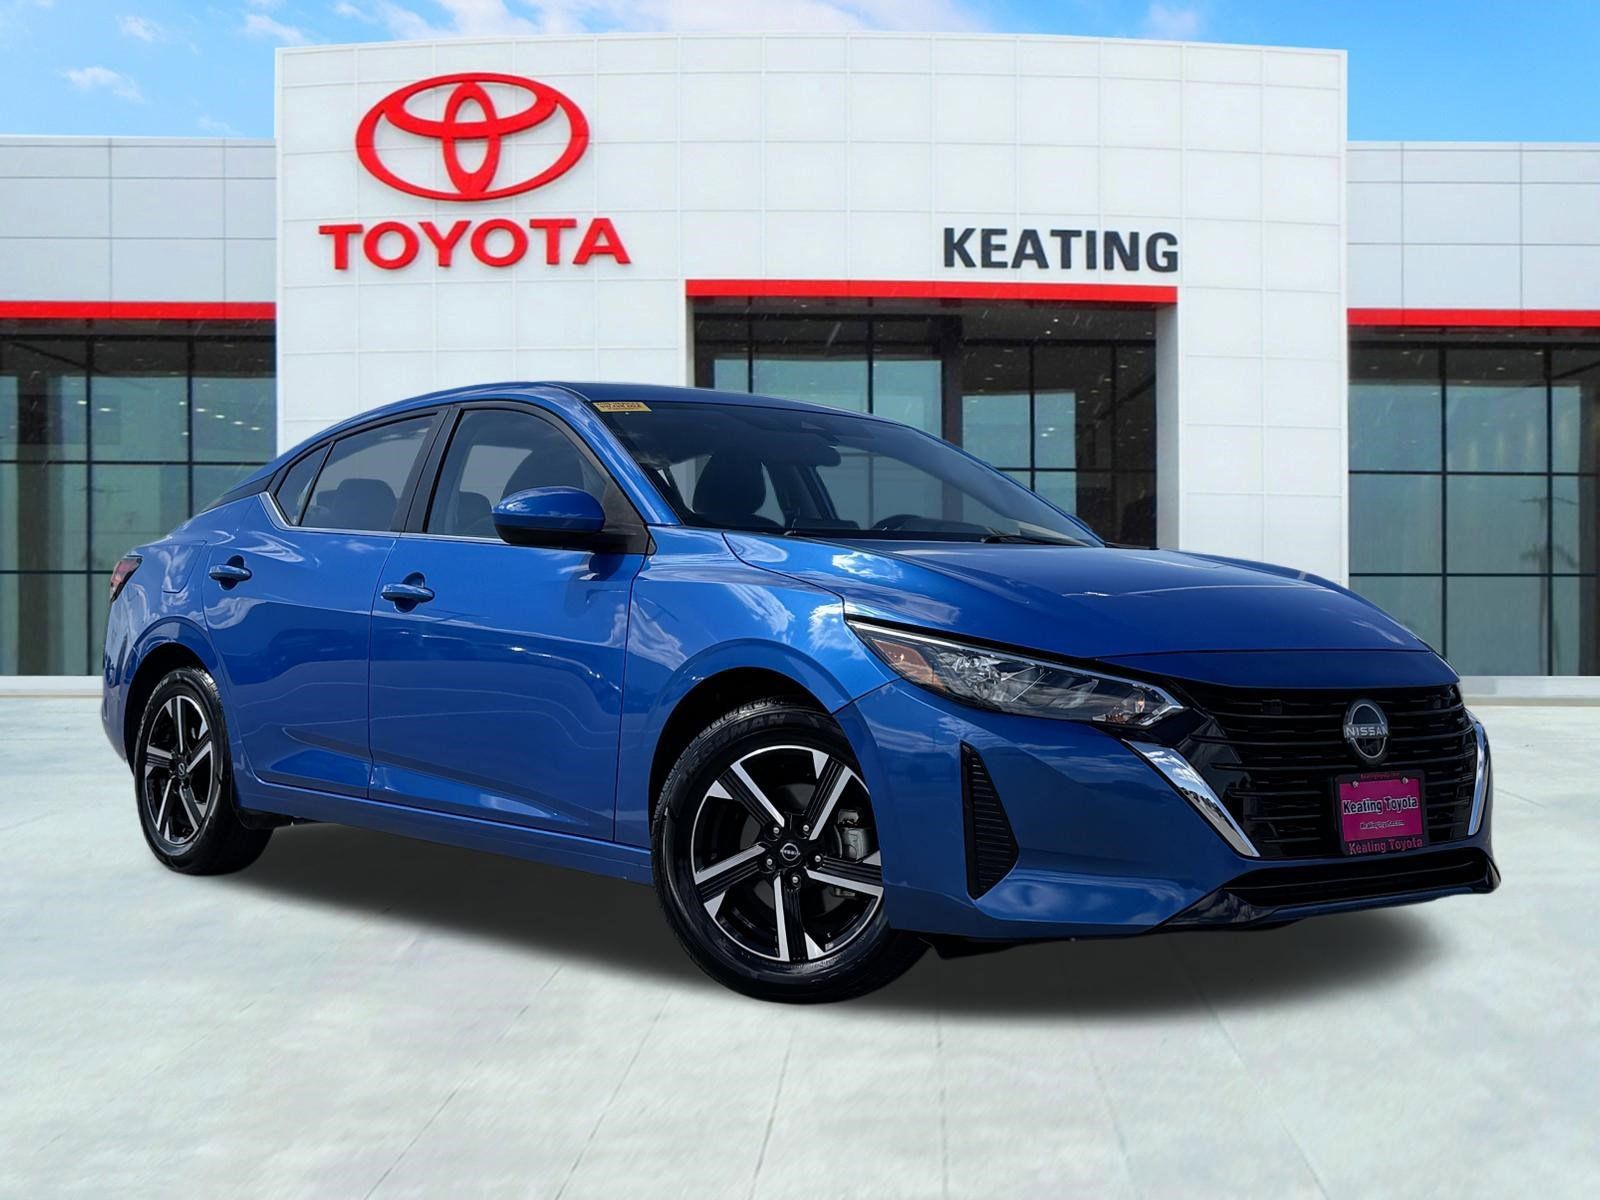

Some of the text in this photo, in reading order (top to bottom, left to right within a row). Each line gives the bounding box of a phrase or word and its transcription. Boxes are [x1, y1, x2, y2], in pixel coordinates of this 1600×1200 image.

[319, 218, 632, 270] TOYOTA
[943, 227, 1179, 272] KEATING
[1345, 726, 1389, 736] NISSAN
[1343, 795, 1418, 815] Keating Toyota
[1348, 837, 1424, 855] Keating Toyota
